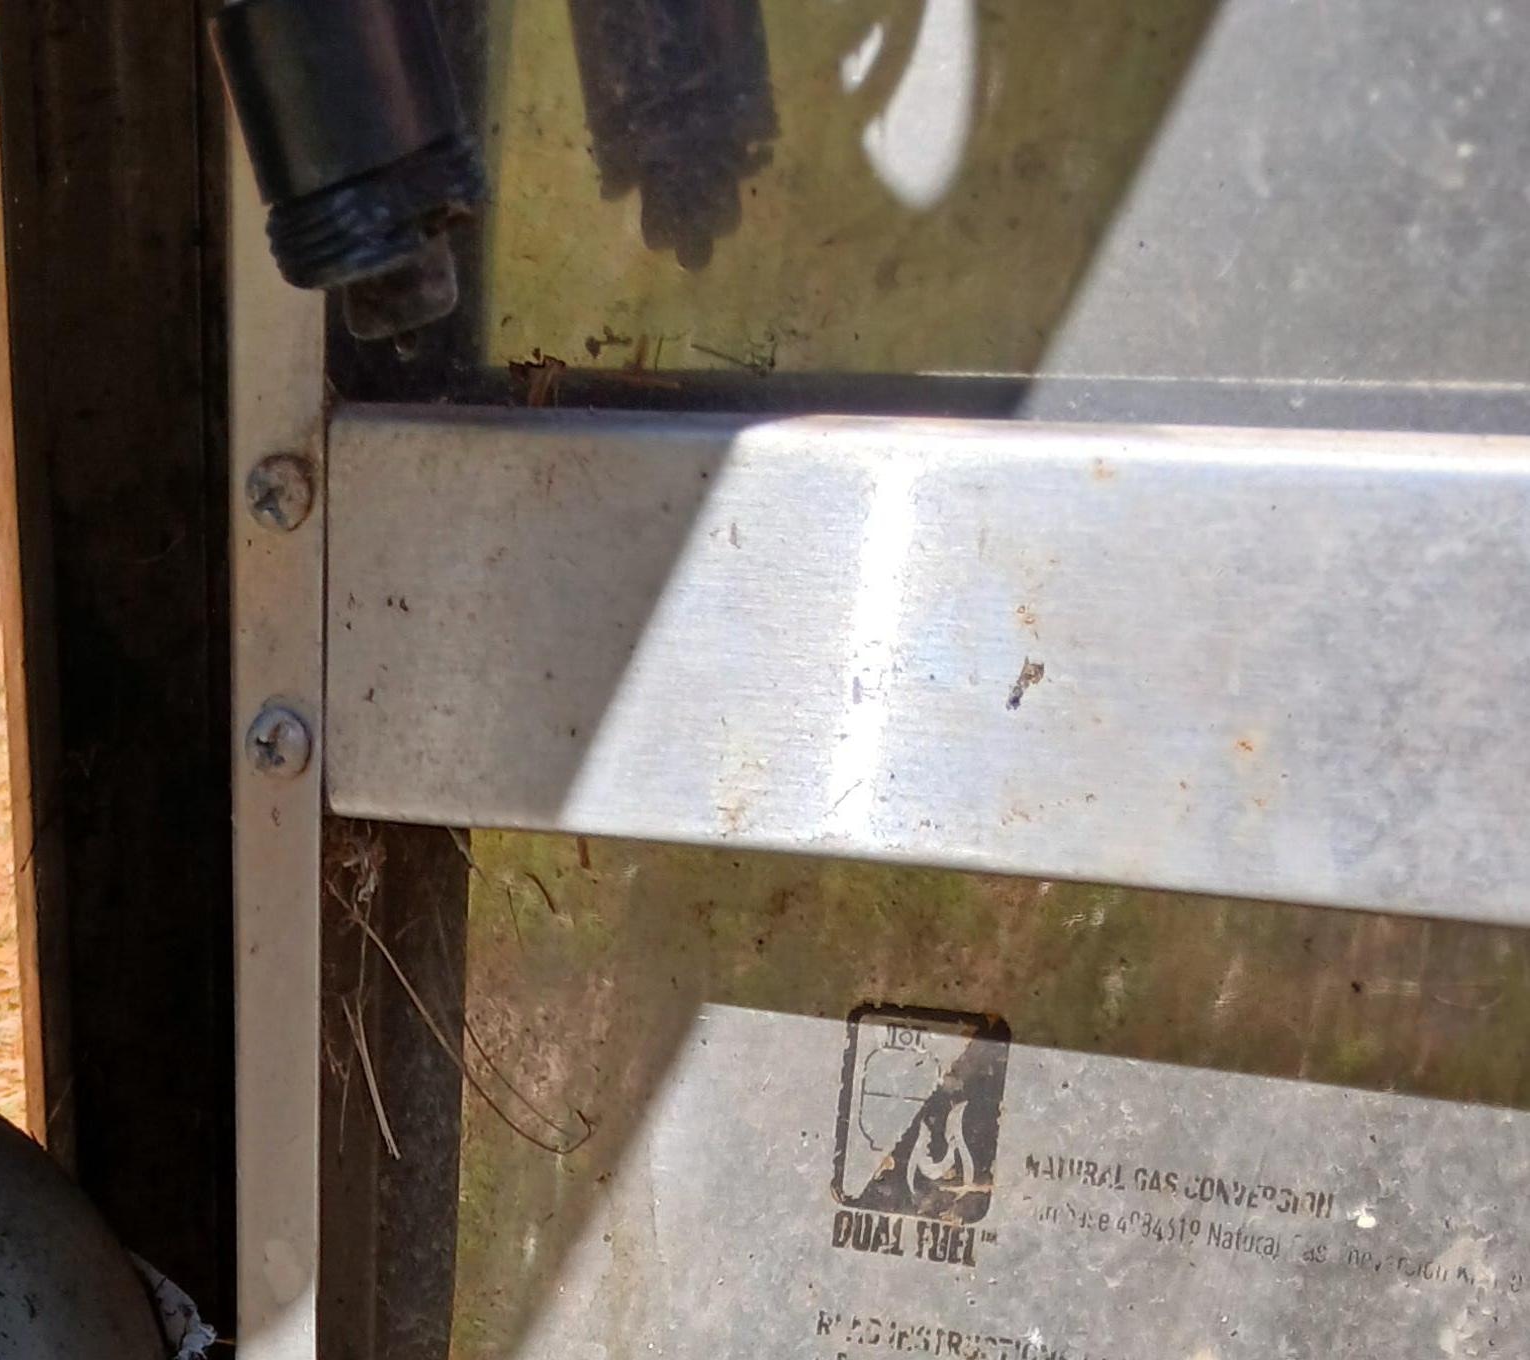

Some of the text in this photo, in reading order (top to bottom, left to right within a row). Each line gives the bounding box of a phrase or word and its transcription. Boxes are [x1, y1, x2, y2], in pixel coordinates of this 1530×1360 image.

[1134, 1169, 1178, 1193] GAS
[831, 1210, 904, 1256] DUAL
[916, 1221, 976, 1267] FUEL
